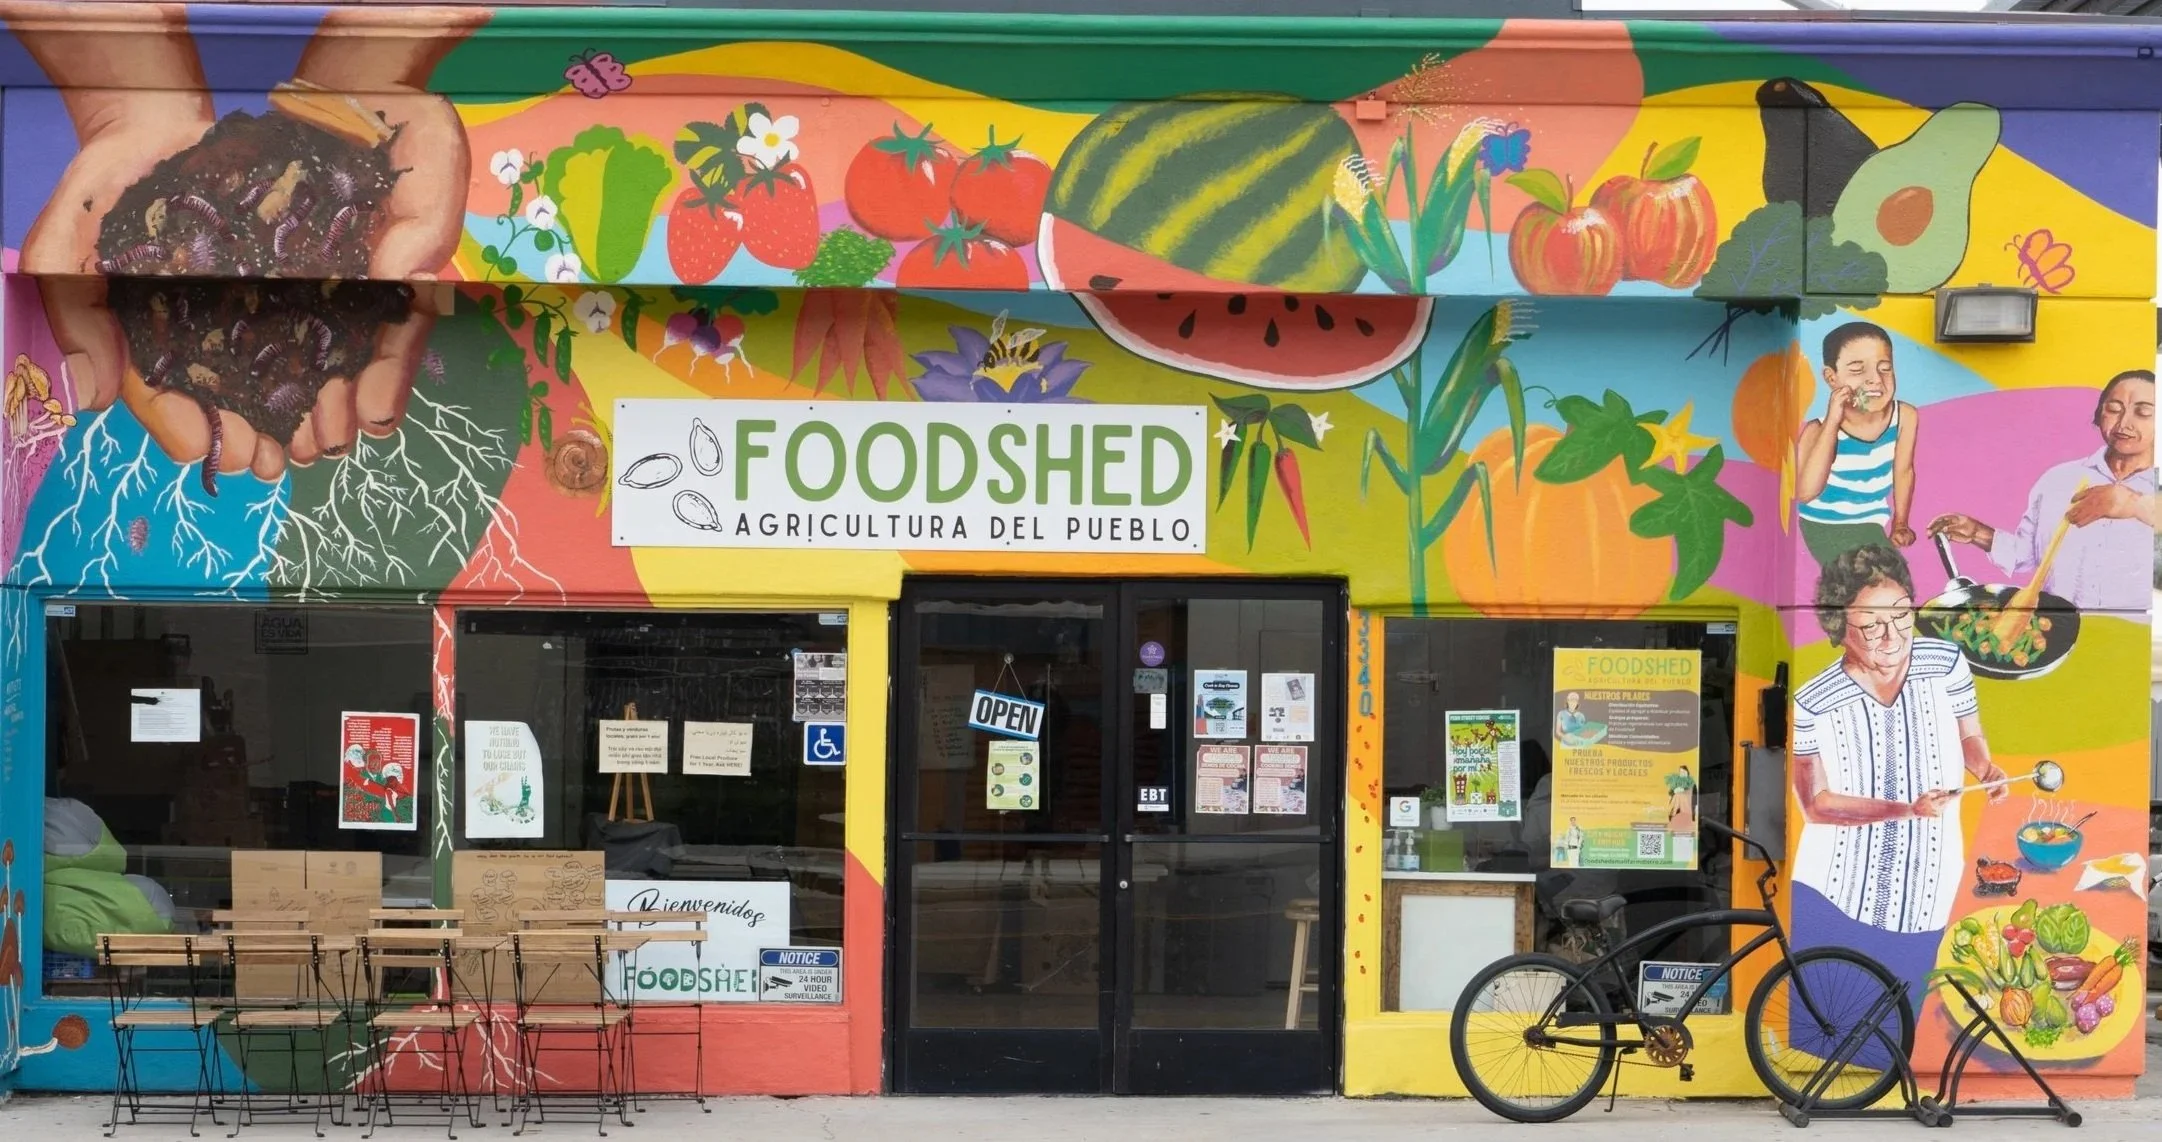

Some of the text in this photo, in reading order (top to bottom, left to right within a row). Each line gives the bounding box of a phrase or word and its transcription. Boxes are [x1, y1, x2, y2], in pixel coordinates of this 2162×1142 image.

[734, 419, 1193, 507] FOODSHED
[735, 512, 1191, 543] AGRICULTURA DEL PUEBLO
[1587, 656, 1692, 676] FOODSHED
[1588, 677, 1641, 685] AGRICULTURA
[1662, 678, 1692, 686] PUEBLO
[1584, 691, 1650, 700] NUESTROS PILARES
[975, 696, 1038, 734] OPEN
[489, 726, 520, 736] WE HAVE
[483, 750, 494, 760] TO
[513, 750, 527, 760] BUT
[1453, 746, 1467, 757] Hoy
[1572, 749, 1603, 757] PRUEBA
[1564, 758, 1654, 767] NUESTROS PRODUCTOS
[1453, 765, 1465, 774] por
[1568, 767, 1648, 777] FRESCOS Y LOCALES
[1140, 788, 1166, 801] EBT
[627, 888, 766, 928] Bienvenidos
[779, 952, 821, 965] NOTICE
[624, 963, 757, 993] FOODSHE
[1661, 967, 1703, 980] NOTICE
[799, 975, 832, 983] 24 HOUR
[803, 984, 827, 992] VIDEO
[1680, 990, 1690, 998] 24
